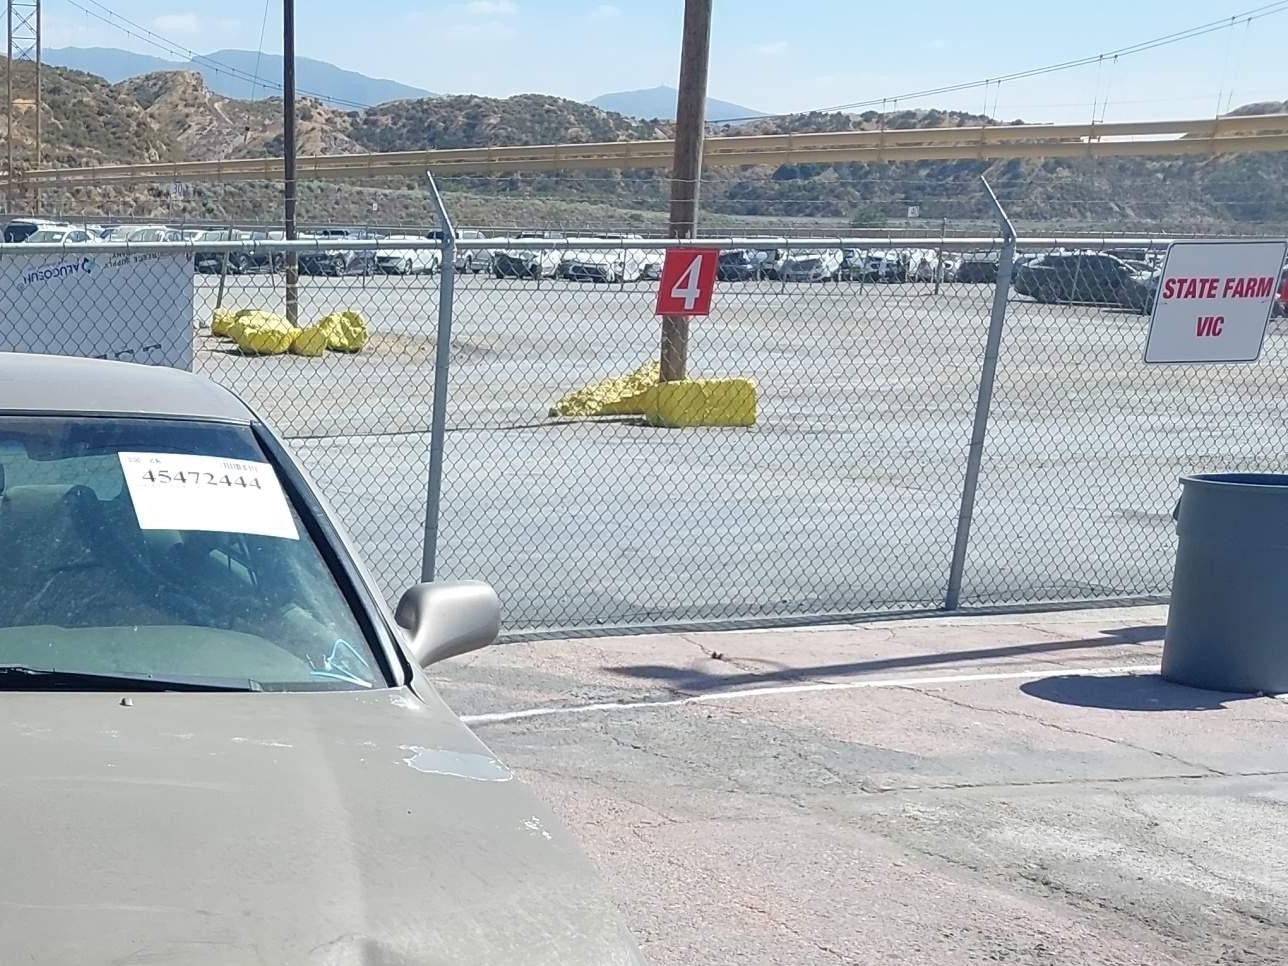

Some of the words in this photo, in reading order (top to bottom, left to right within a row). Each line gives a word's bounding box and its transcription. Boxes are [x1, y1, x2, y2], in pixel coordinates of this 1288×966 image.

[670, 254, 704, 310] 4
[1162, 278, 1220, 300] STATE
[1222, 277, 1275, 299] FARM
[1195, 316, 1225, 337] VIC
[142, 469, 263, 490] 45472444
